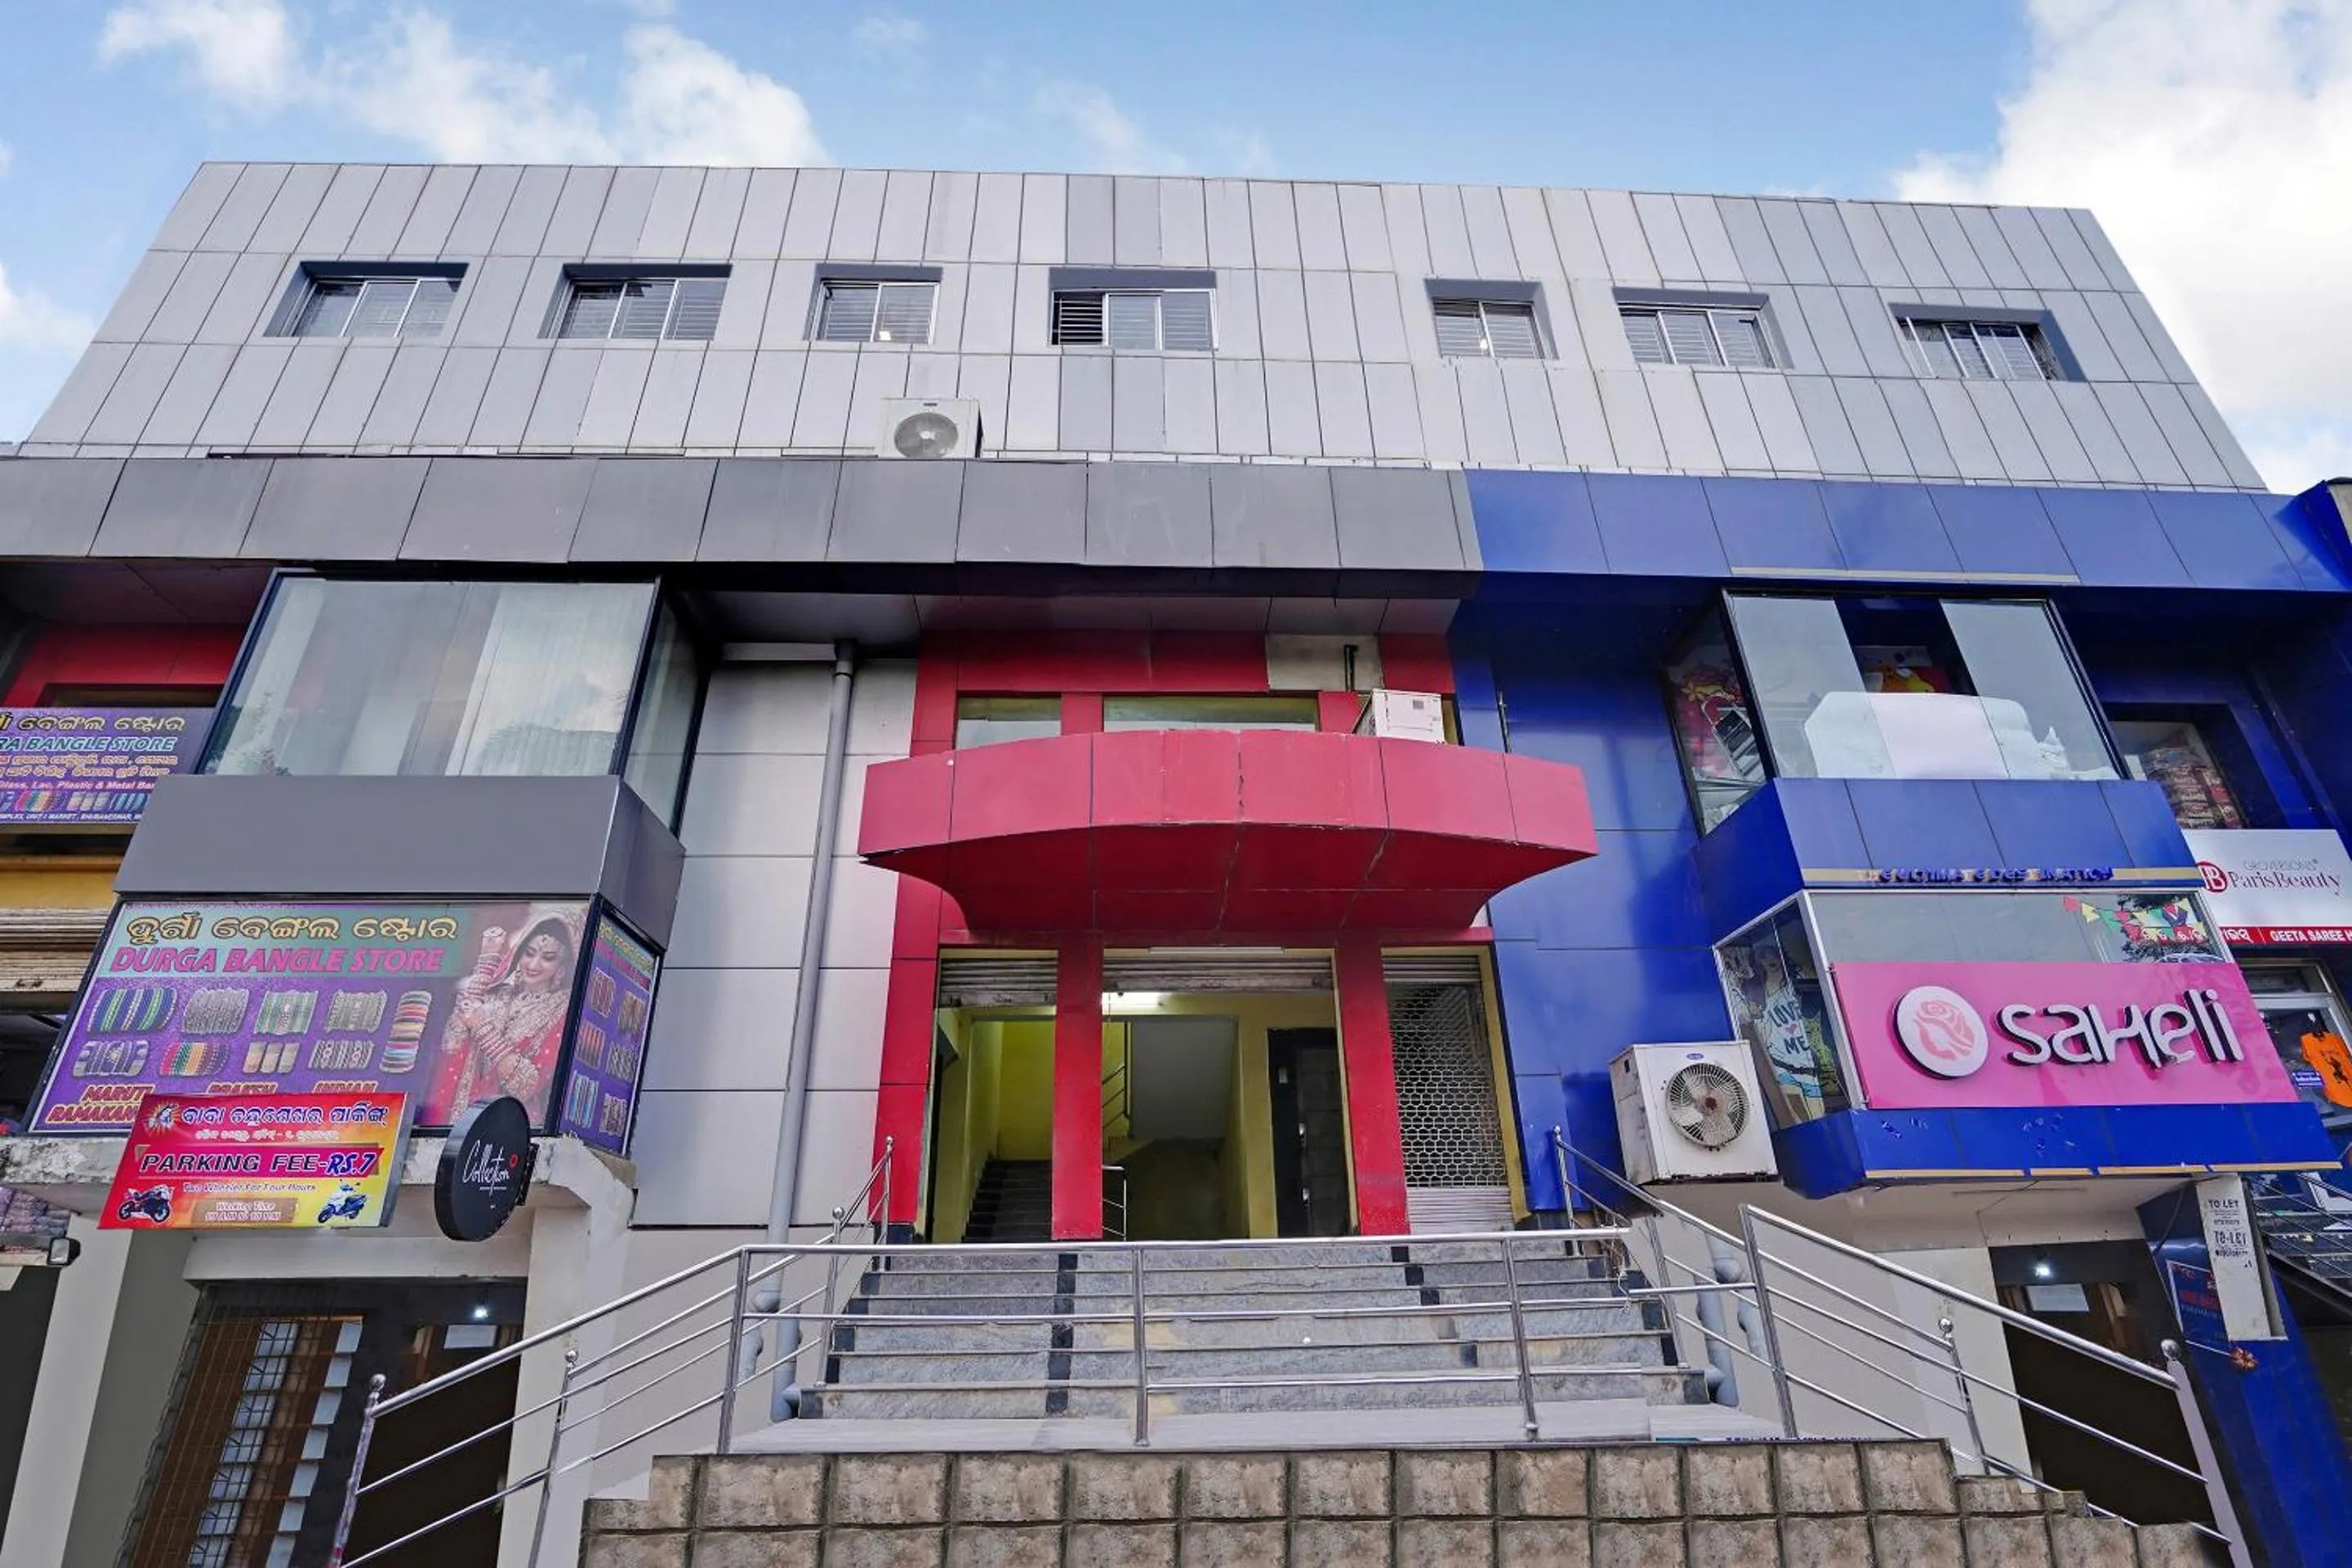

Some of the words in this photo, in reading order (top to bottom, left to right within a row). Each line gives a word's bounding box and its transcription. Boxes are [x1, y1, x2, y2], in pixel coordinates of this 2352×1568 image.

[24, 737, 111, 751] BANGLE
[110, 737, 178, 751] STORE
[2270, 929, 2307, 942] GEETA
[2307, 929, 2346, 942] SAREE
[109, 947, 216, 973] DURGA
[223, 947, 347, 973] BANGLE
[349, 947, 447, 973] STORE
[1784, 1036, 1810, 1054] ME
[140, 1153, 261, 1172] PARKING
[2208, 1199, 2221, 1208] TO
[2222, 1198, 2238, 1208] LET
